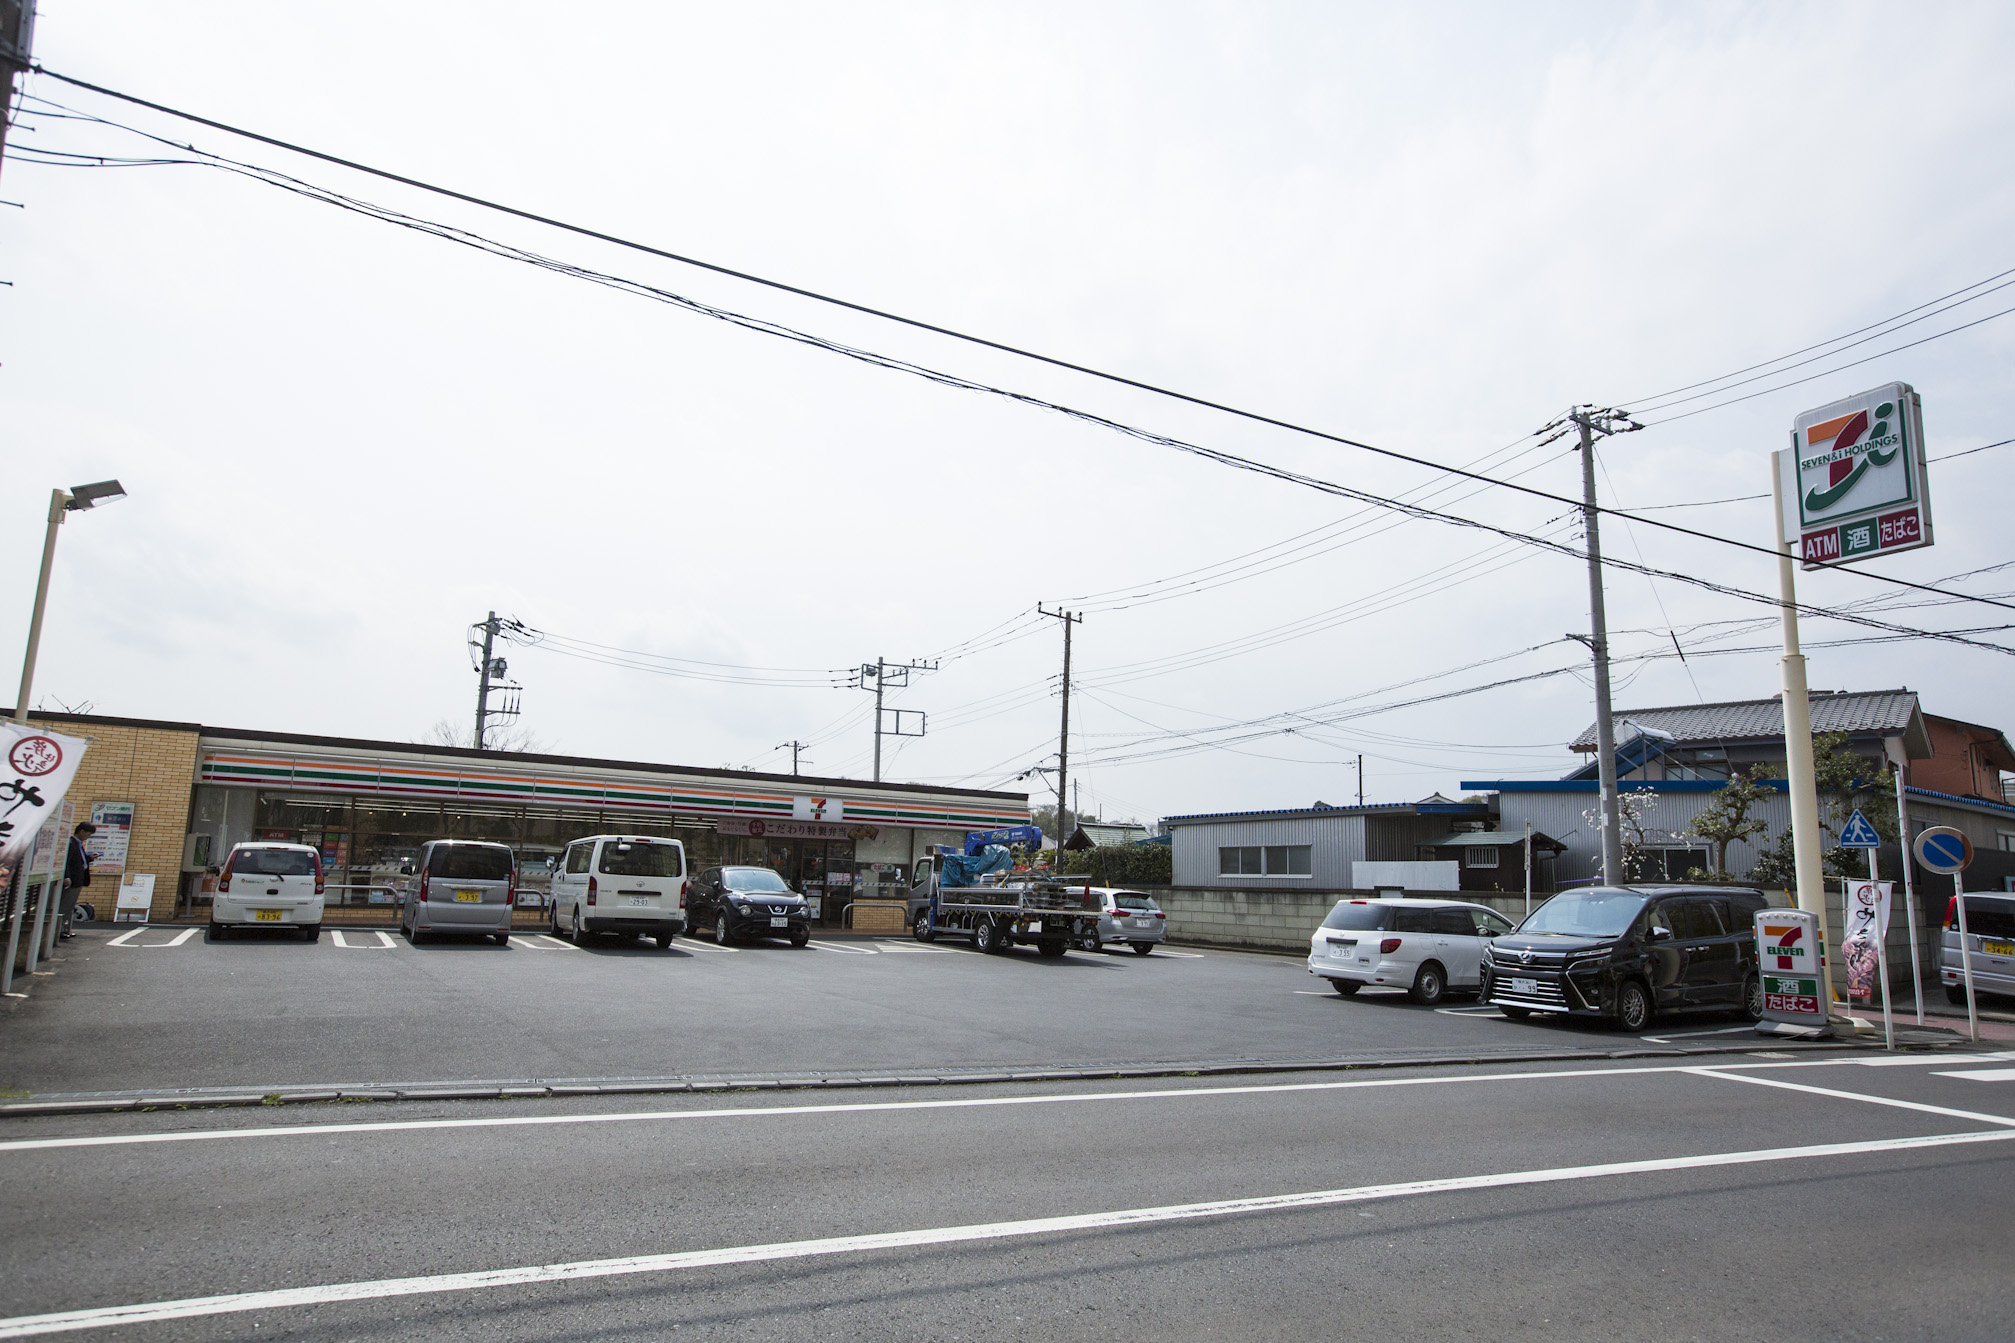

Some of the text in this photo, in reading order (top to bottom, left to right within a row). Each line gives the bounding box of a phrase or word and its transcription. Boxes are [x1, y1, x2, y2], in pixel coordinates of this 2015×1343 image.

[1844, 433, 1898, 457] HOLDINGS
[1847, 526, 1871, 550] 酒
[1880, 516, 1919, 543] たばこ
[1805, 533, 1838, 559] ATM
[766, 823, 848, 838] こだわり特製弁当
[1776, 978, 1800, 994] 酒
[1767, 994, 1815, 1012] たばこ
